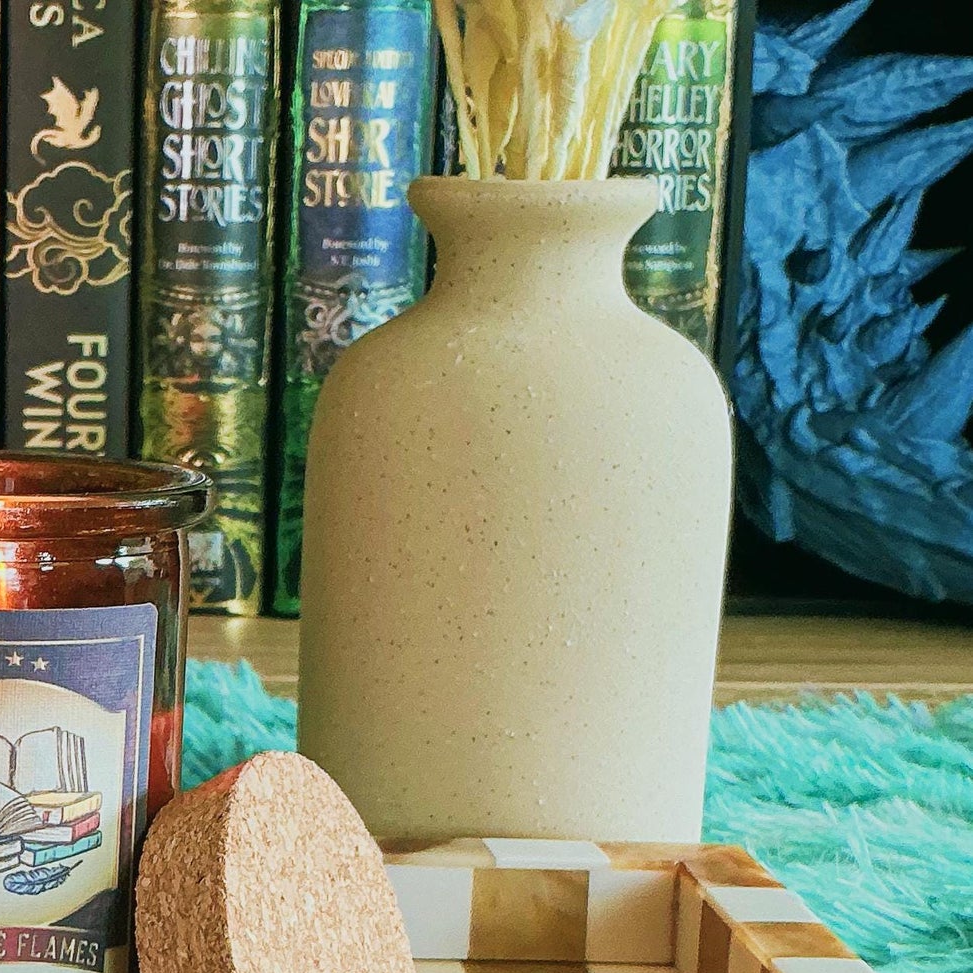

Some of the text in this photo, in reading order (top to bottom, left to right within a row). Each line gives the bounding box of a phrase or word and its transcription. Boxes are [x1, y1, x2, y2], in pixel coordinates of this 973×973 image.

[645, 39, 720, 81] ARY
[159, 80, 267, 130] GHOST
[629, 80, 719, 125] HELLEY
[162, 133, 264, 182] SHORT
[306, 116, 400, 168] SHR
[158, 183, 264, 227] STORIES
[303, 168, 400, 208] STOIE
[21, 360, 66, 449] WIN
[65, 333, 109, 456] FOUR
[15, 933, 100, 967] FLAMES
